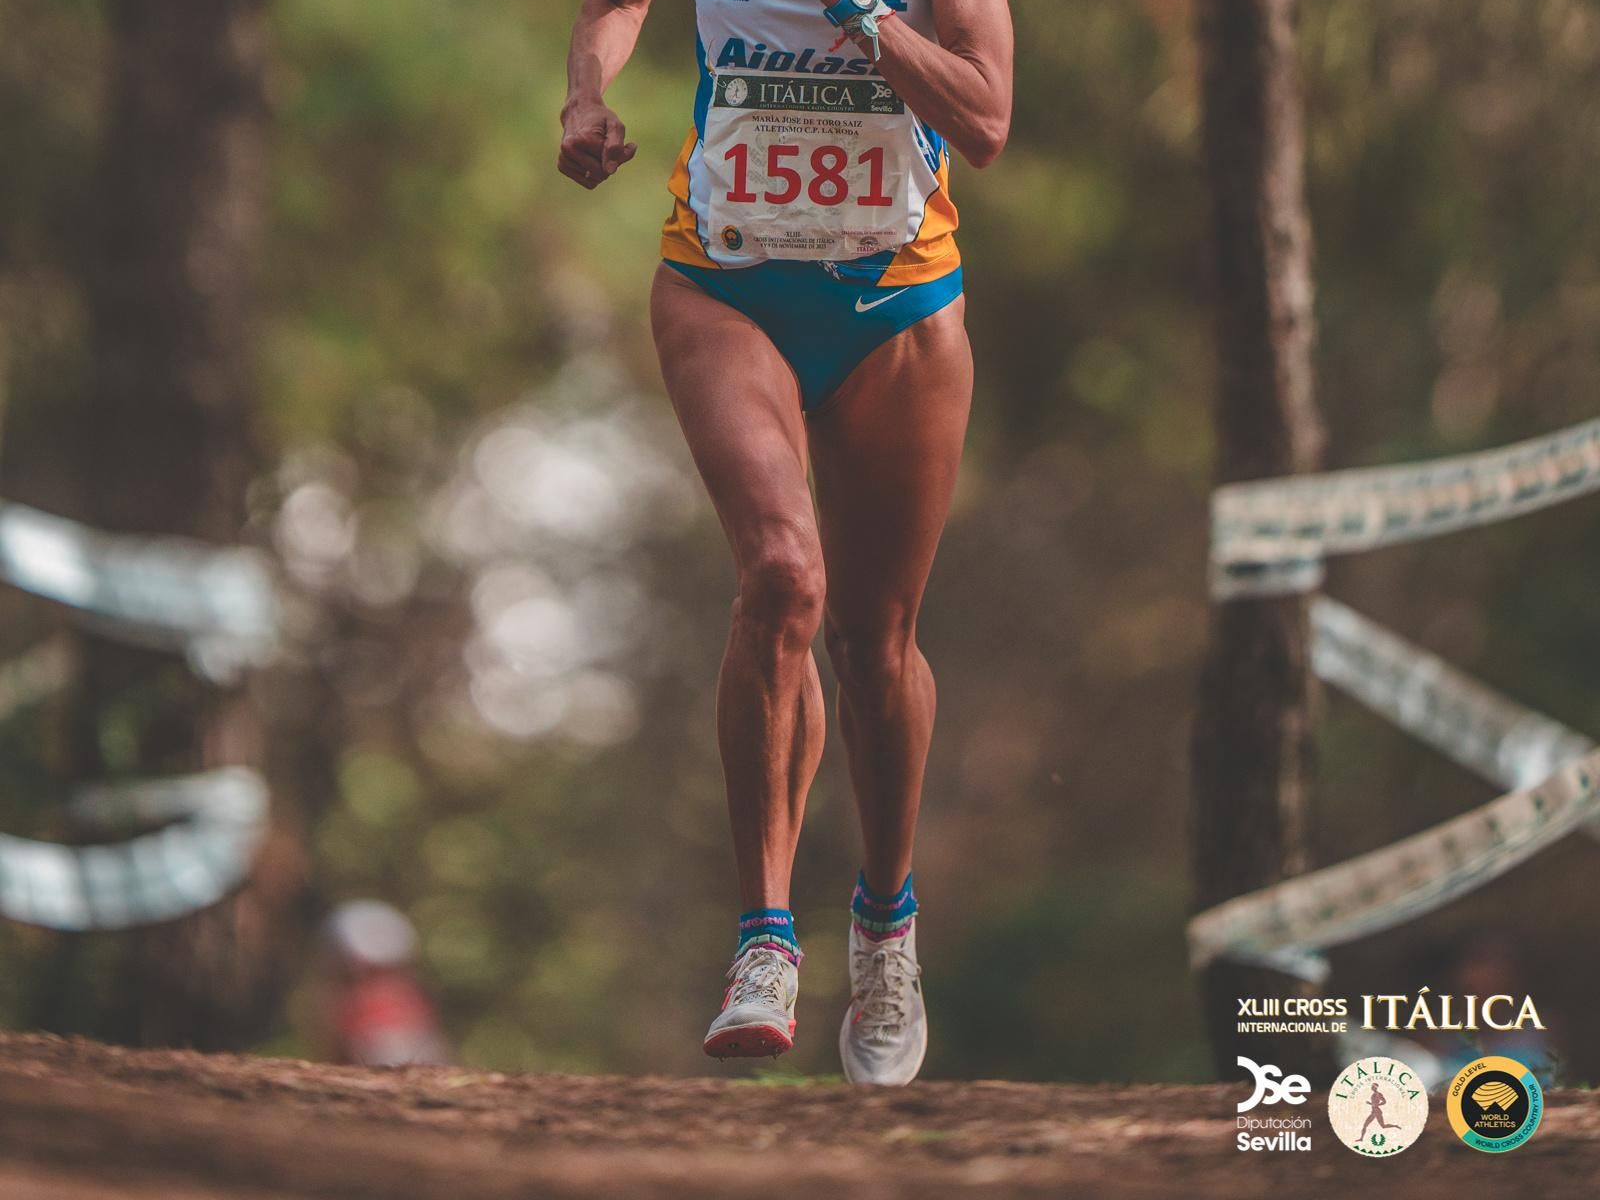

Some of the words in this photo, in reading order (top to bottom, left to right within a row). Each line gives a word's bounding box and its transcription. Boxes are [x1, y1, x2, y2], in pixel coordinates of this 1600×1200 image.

[760, 80, 854, 105] ITÁLICA
[752, 115, 781, 124] MARÍA
[843, 120, 862, 128] SAIZ
[754, 125, 802, 133] ATLETISMO
[834, 128, 860, 136] RODA
[724, 143, 893, 206] 1581
